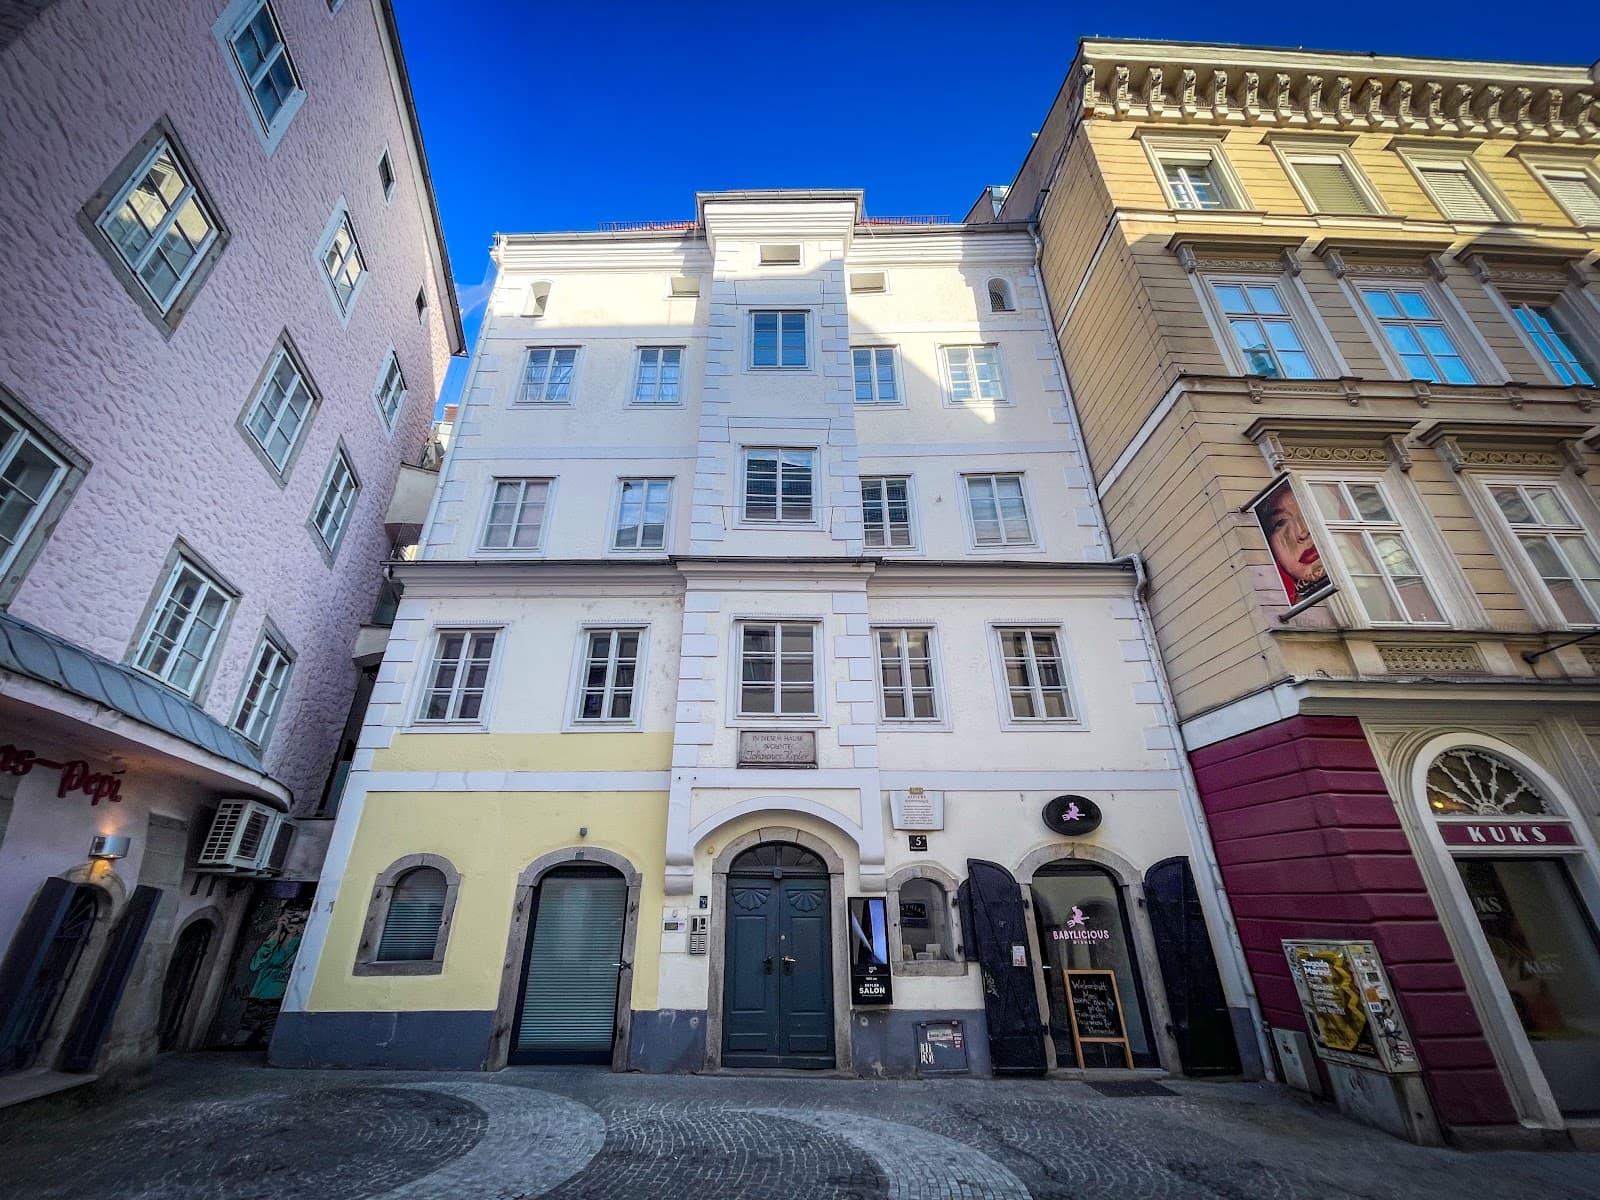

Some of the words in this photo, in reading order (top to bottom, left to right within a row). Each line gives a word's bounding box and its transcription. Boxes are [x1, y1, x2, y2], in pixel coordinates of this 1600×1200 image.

[915, 836, 922, 846] 5
[1467, 826, 1548, 843] KUKS
[1472, 896, 1502, 912] UKS
[1052, 929, 1110, 940] BABYLICIOUS
